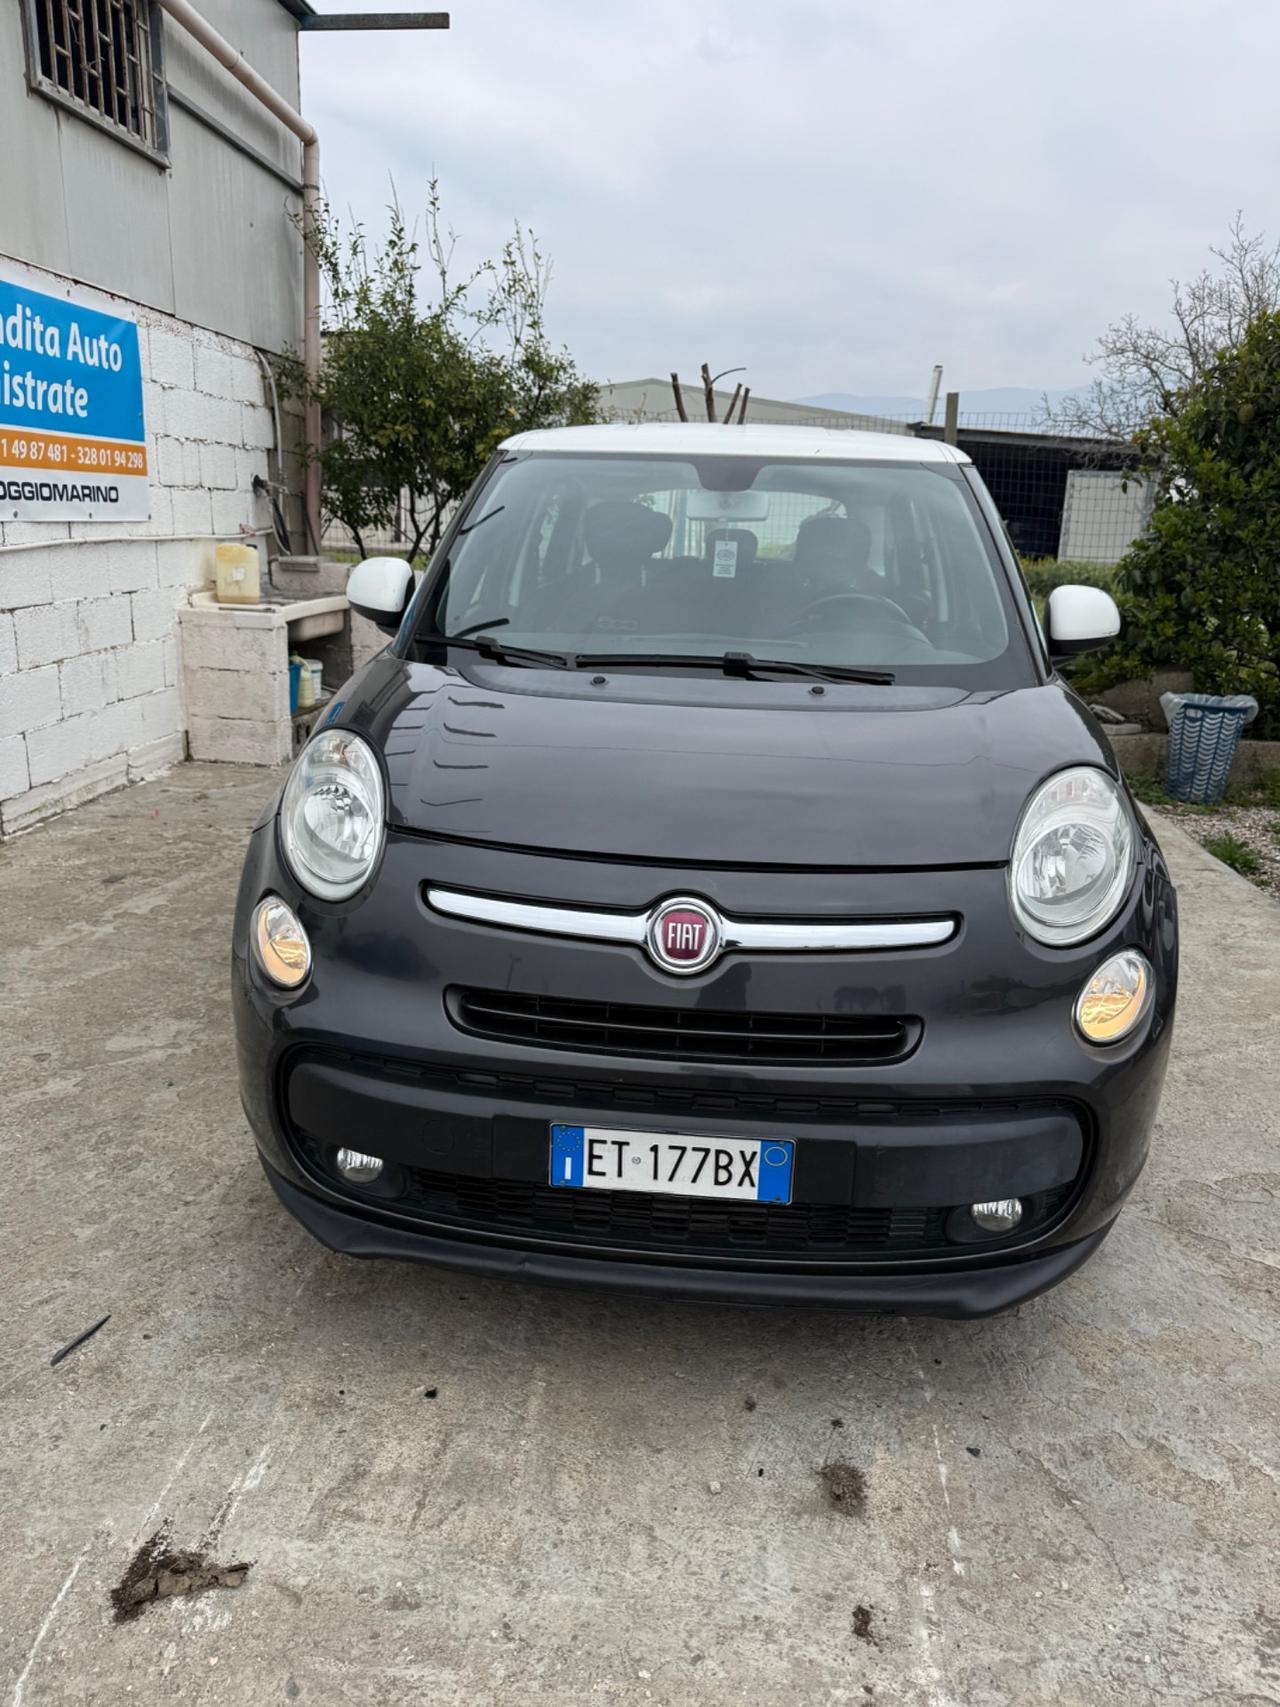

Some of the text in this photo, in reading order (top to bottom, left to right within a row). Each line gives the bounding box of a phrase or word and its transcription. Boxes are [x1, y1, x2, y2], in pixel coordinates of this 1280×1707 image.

[0, 303, 122, 372] dita Auto
[3, 359, 89, 418] istrate
[2, 438, 8, 458] 1
[11, 439, 28, 459] 49
[29, 441, 45, 460] 87
[47, 443, 68, 462] 481
[77, 446, 98, 465] 328
[99, 449, 112, 466] 01
[114, 450, 127, 467] 94
[127, 452, 144, 469] 298
[667, 922, 703, 951] FIAT
[587, 1138, 631, 1179] ET
[649, 1143, 758, 1188] 177BX
